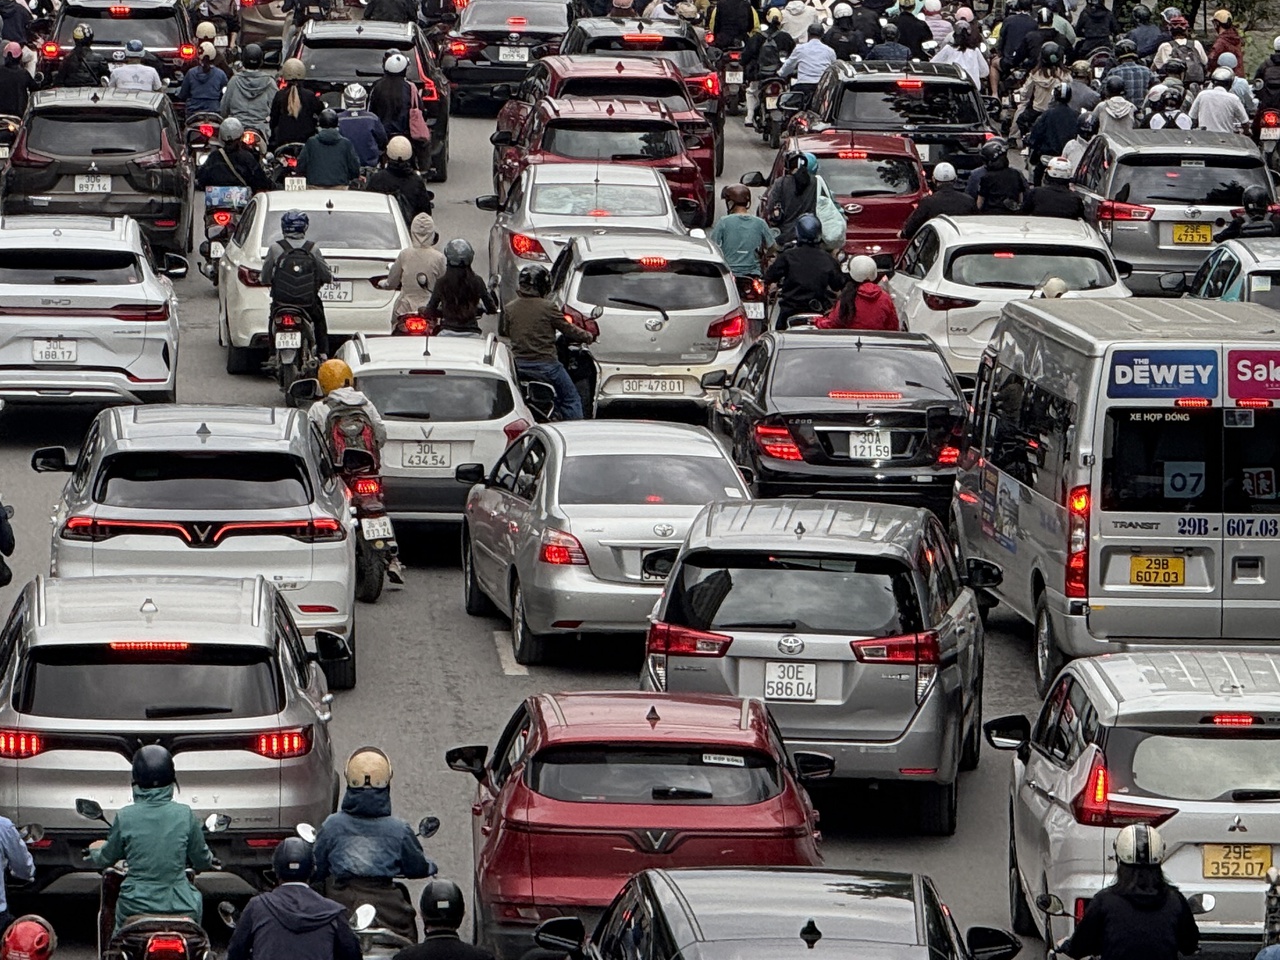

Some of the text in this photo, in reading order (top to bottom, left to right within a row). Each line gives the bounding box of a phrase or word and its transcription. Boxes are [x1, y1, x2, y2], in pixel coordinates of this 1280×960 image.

[38, 351, 72, 360] 188.17
[1115, 364, 1214, 384] DEWEY
[1130, 413, 1142, 421] XE
[1143, 412, 1162, 423] HỢP
[860, 432, 881, 444] 30A
[417, 443, 437, 455] 30L
[408, 455, 445, 466] 434.54
[1170, 472, 1203, 493] 07
[1112, 521, 1160, 530] TRANSIT
[1177, 518, 1209, 537] 29B
[1226, 518, 1279, 538] 607.03
[1145, 558, 1169, 570] 29B
[1136, 571, 1178, 583] 607.03
[778, 664, 805, 680] 30E
[766, 681, 813, 697] 586.04
[1223, 845, 1252, 860] 29E
[1210, 861, 1264, 876] 352.07
